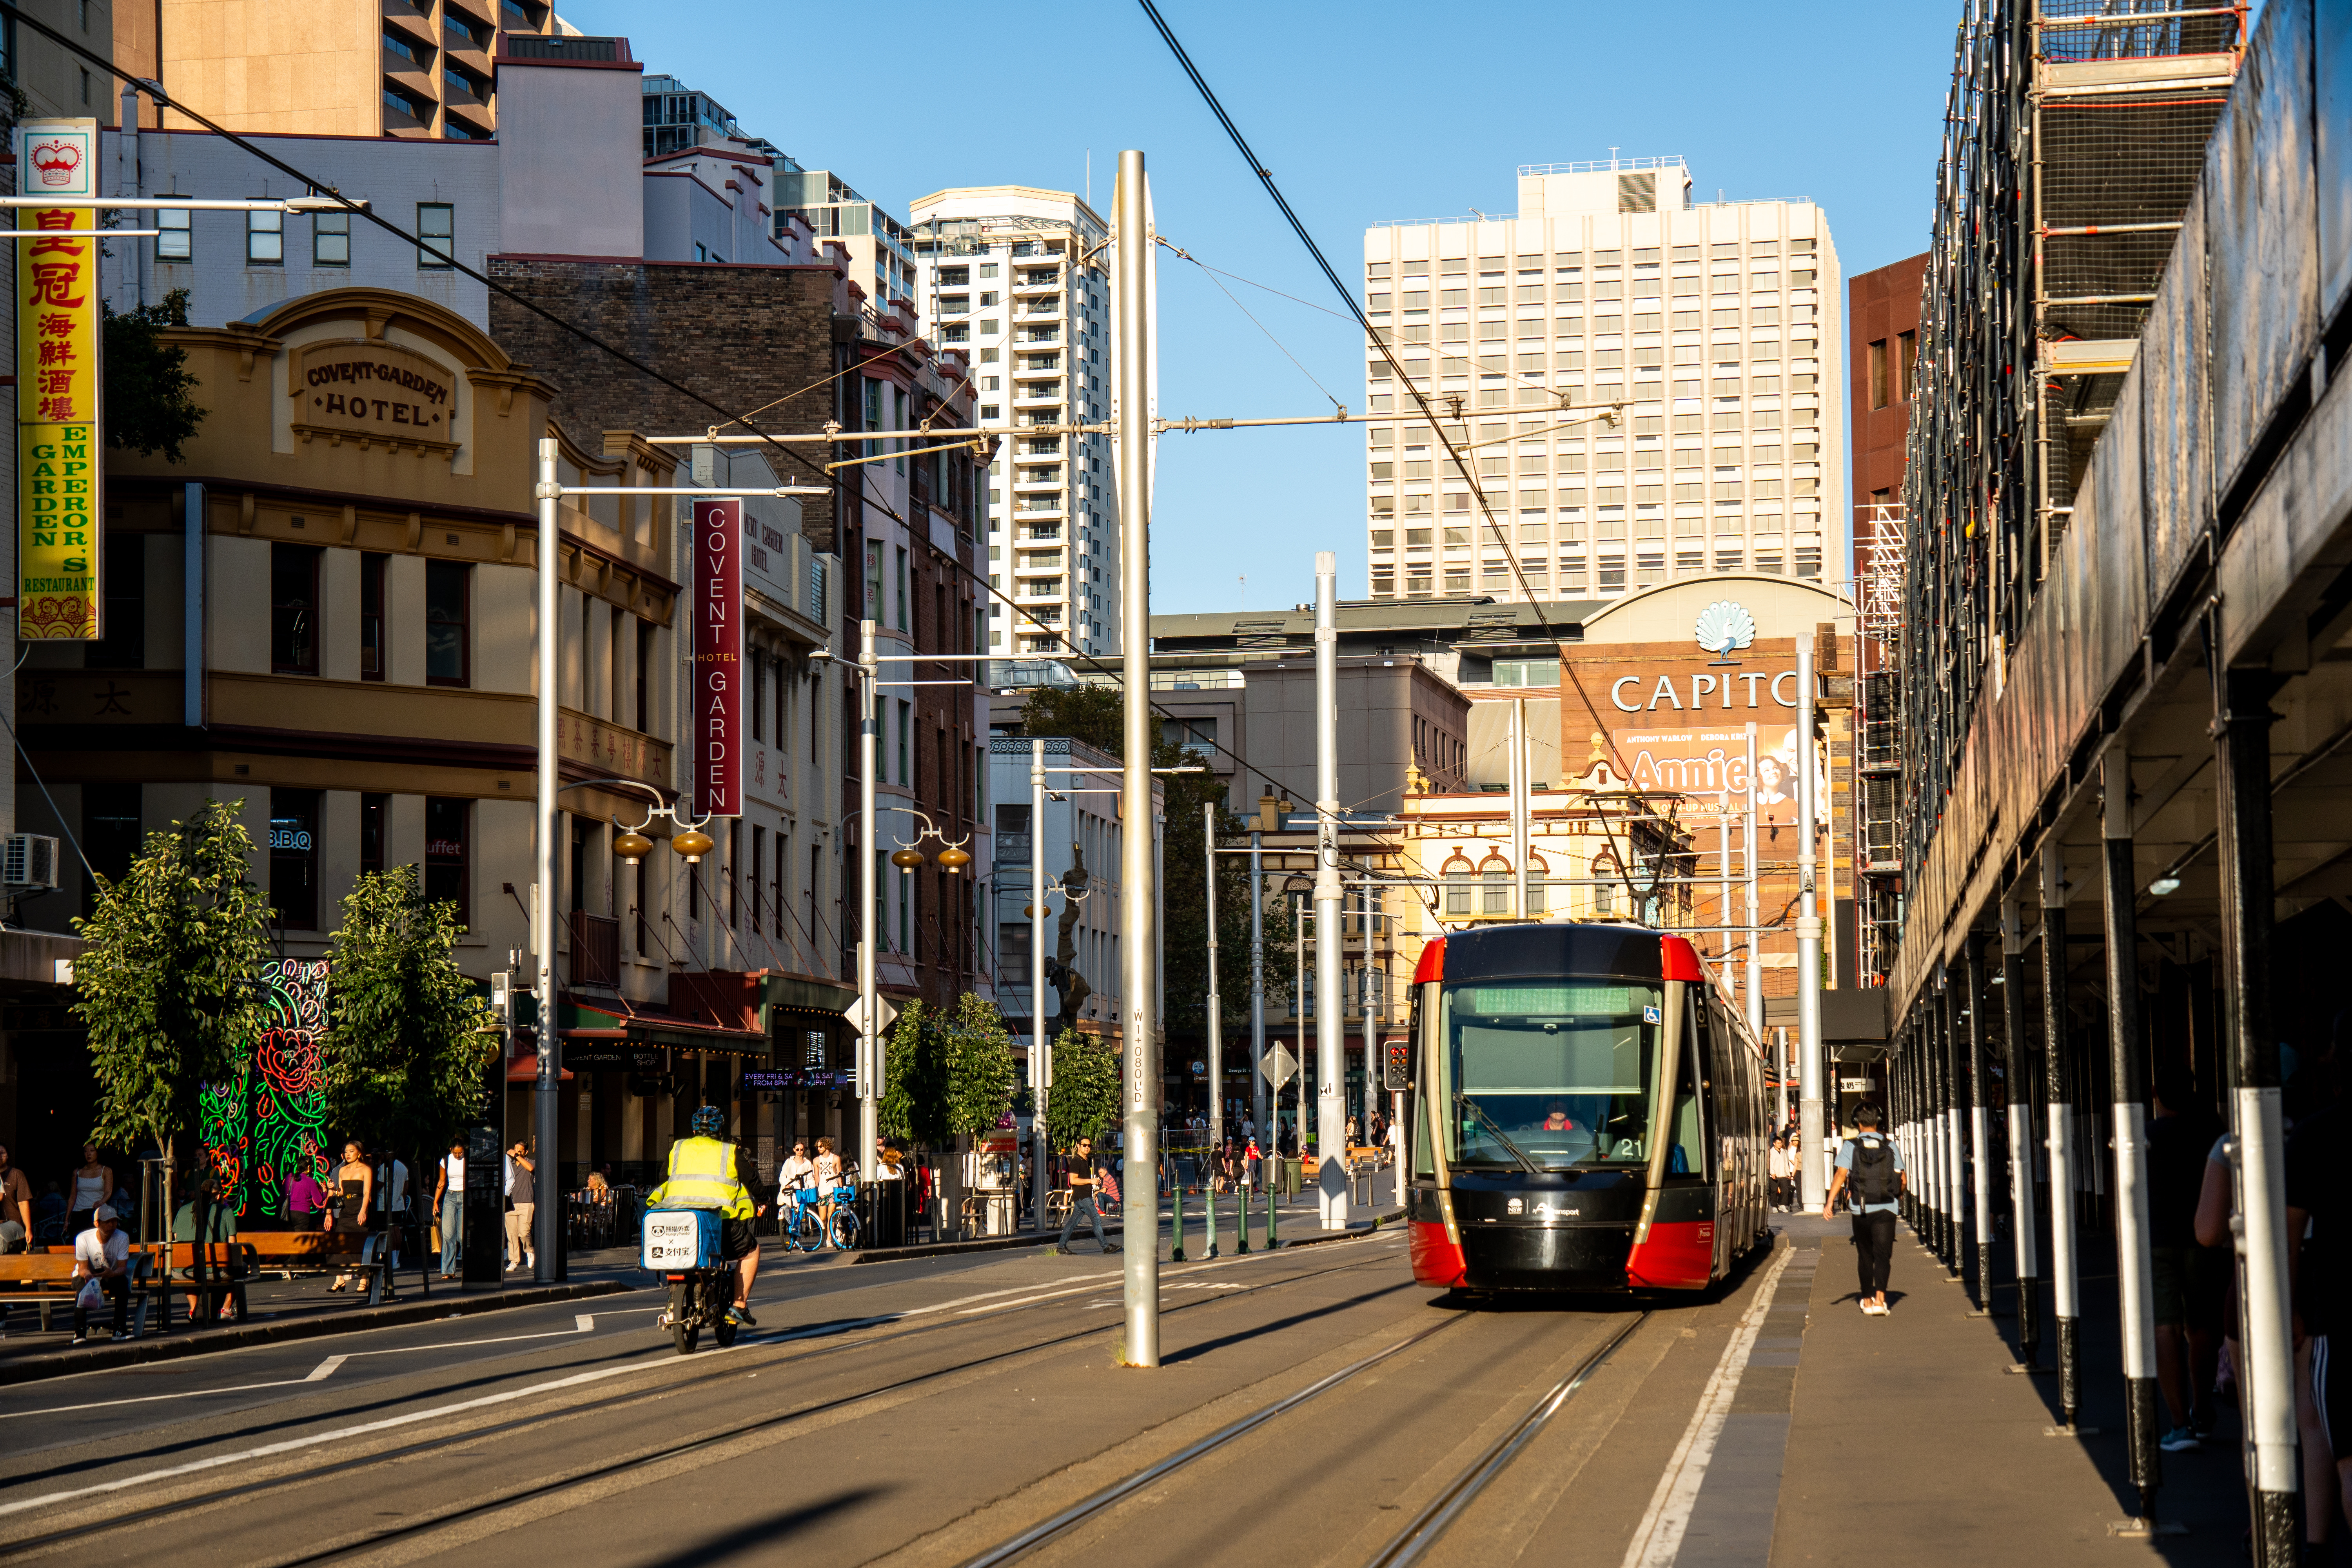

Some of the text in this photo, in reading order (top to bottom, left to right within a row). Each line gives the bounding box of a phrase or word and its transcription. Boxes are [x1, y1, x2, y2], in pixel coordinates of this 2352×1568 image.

[307, 361, 448, 404] COVENT GARDEN
[326, 392, 429, 427] HOTEL
[32, 445, 57, 546] GARDEN
[744, 512, 758, 539] VENT
[751, 544, 769, 573] HOTEL
[24, 577, 95, 592] RESTAURANT
[708, 508, 726, 644] COVENT
[698, 653, 737, 662] HOTEL
[1612, 671, 1797, 713] CAPITO
[709, 672, 726, 807] GARDEN
[1628, 748, 1747, 794] Annie
[1700, 802, 1740, 812] MUSAL
[426, 840, 460, 855] uffet
[1698, 997, 1703, 1006] A
[1621, 1138, 1642, 1157] 21
[665, 1247, 689, 1256] 支付宝
